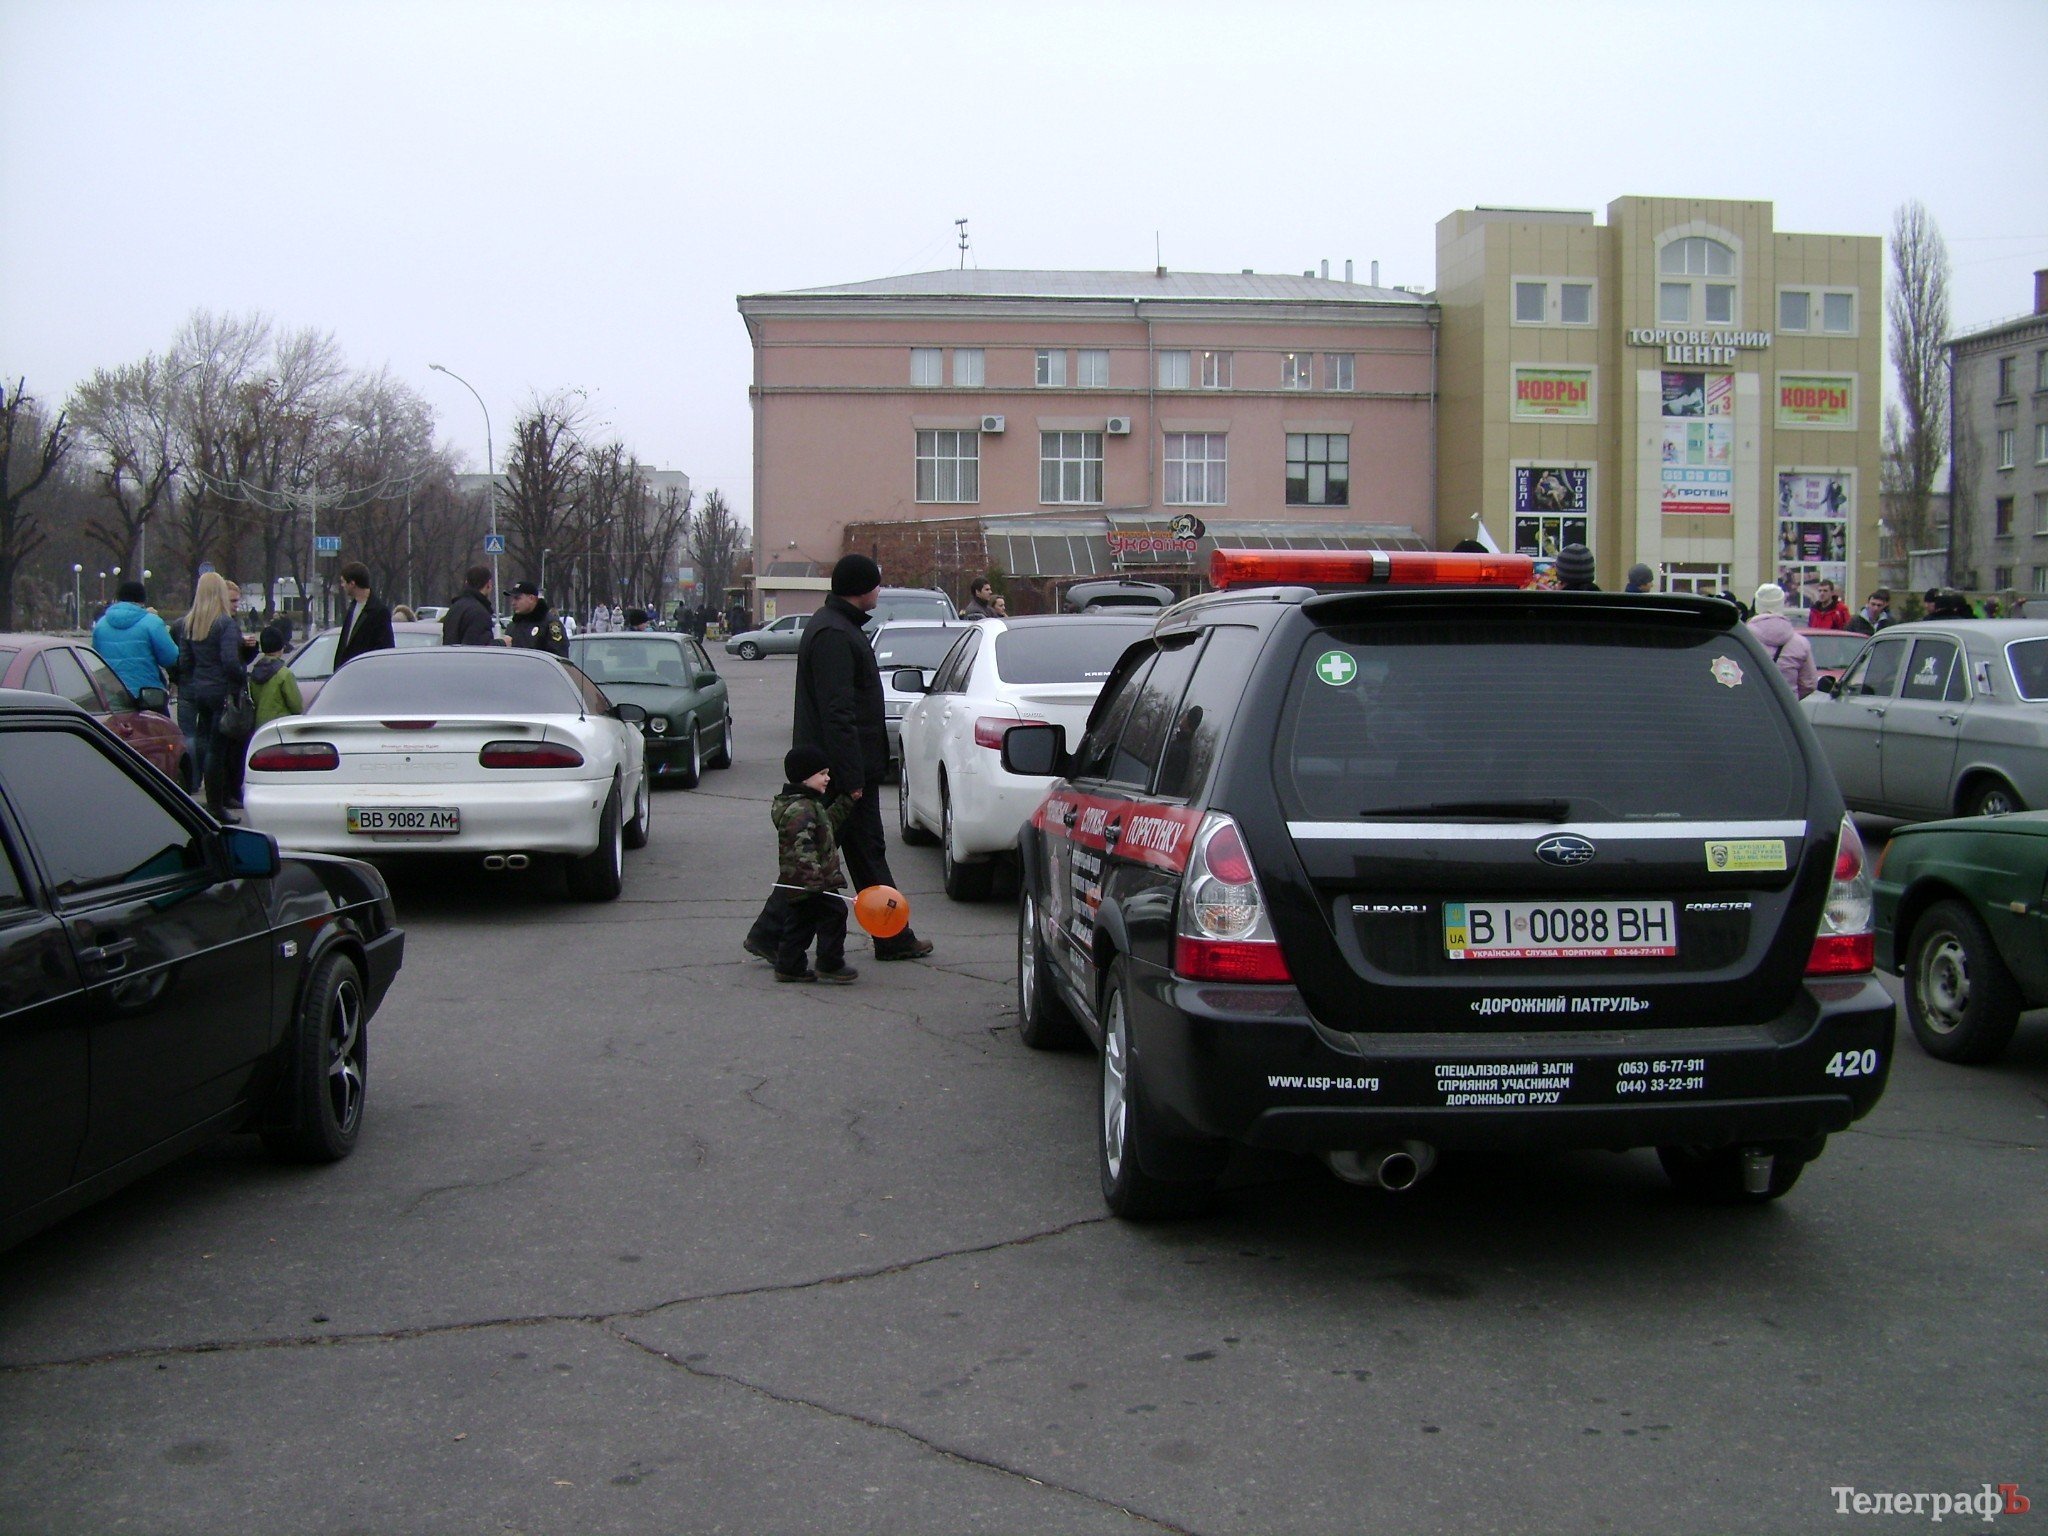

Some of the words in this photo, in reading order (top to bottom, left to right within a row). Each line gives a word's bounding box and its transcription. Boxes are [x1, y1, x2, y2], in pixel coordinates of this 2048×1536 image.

[1667, 345, 1736, 364] ЦЕНТР
[1517, 380, 1587, 401] КОВРЫ
[1781, 387, 1848, 409] КОВРЫ
[1518, 469, 1529, 508] МЕБЛІ
[1573, 470, 1585, 508] ШТОРИ
[1106, 530, 1197, 556] Україна
[387, 812, 425, 828] 9082
[1125, 815, 1186, 854] ПОРЯТУНКУ
[1352, 905, 1427, 913] SUBARU
[1685, 902, 1752, 911] FORESTER
[1530, 908, 1609, 943] 0088
[1450, 934, 1465, 944] UA
[1472, 950, 1521, 958] УКРАЇНСЬКА
[1525, 949, 1558, 957] СЛУЖБА
[1562, 949, 1607, 957] ПОРЯТУНКУ
[1613, 947, 1665, 956] 063-66-77-911
[1470, 995, 1566, 1015] «ДОРОЖНИЙ
[1571, 996, 1650, 1012] ПАТРУЛЬ»
[1435, 1061, 1539, 1078] СПЕЦІАЛІЗОВАНИЙ
[1542, 1063, 1574, 1075] ЗАГІН
[1618, 1061, 1648, 1075] (063)
[1652, 1058, 1704, 1073] 66-77-911
[1825, 1049, 1876, 1077] 420
[1268, 1075, 1379, 1091] www.usp-ua.org
[1437, 1078, 1498, 1091] СПРИЯННЯ
[1501, 1077, 1570, 1090] УЧАСНИКАМ
[1616, 1080, 1646, 1094] (044)
[1650, 1077, 1704, 1092] 33-22-911
[1446, 1092, 1526, 1106] ДОРОЖНЬОГО
[1529, 1092, 1560, 1104] РУХУ
